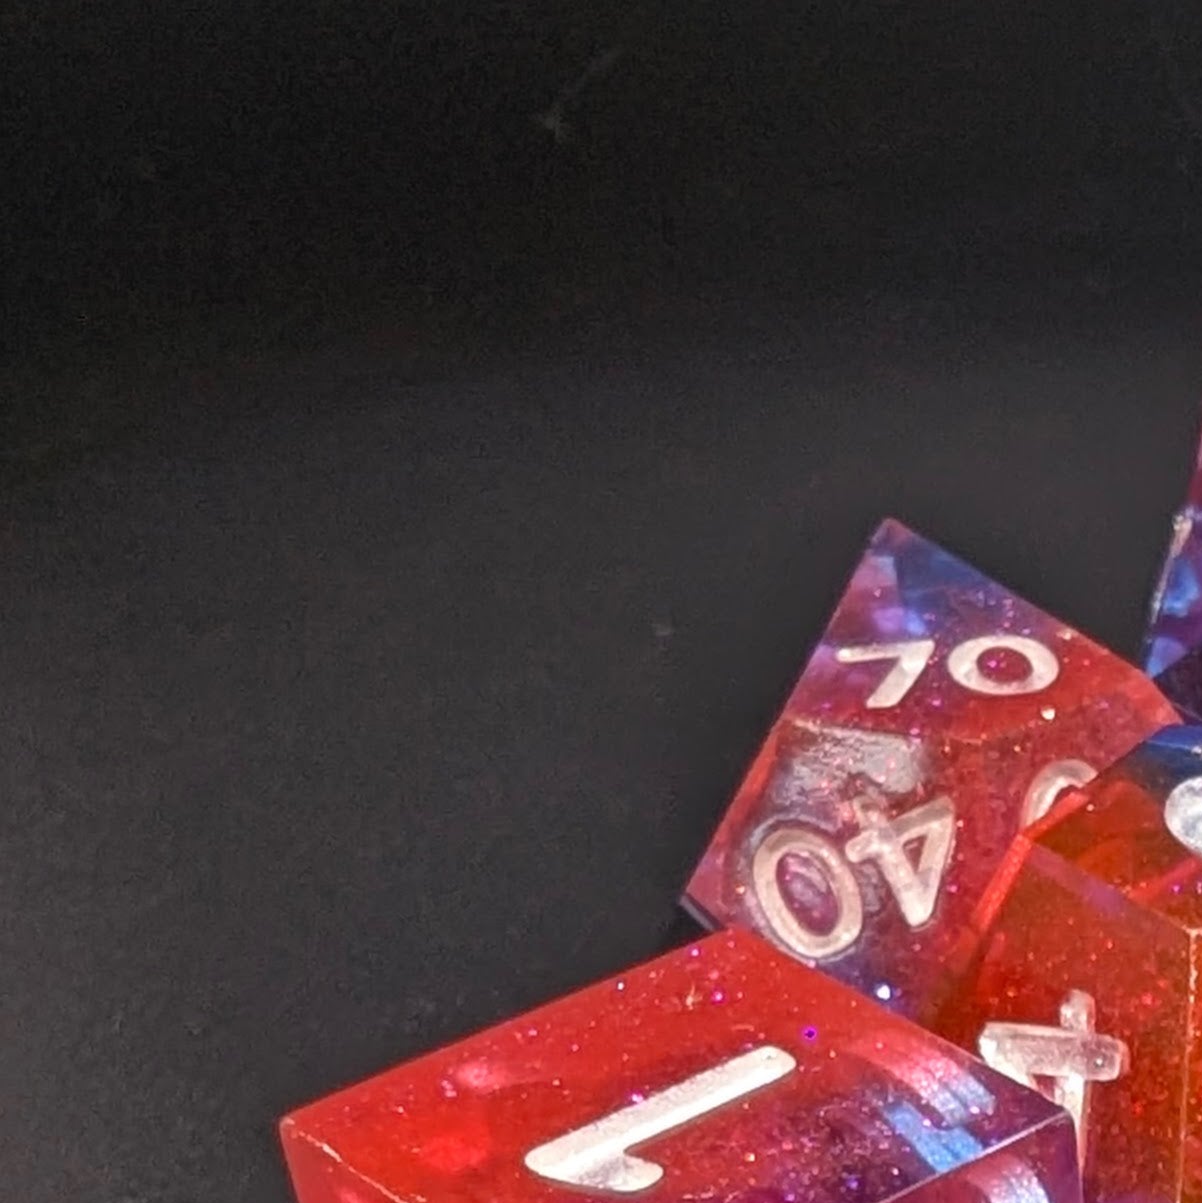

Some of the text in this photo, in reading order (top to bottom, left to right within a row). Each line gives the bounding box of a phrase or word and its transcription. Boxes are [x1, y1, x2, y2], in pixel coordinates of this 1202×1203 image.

[835, 634, 1061, 710] 70
[752, 795, 958, 960] 40
[523, 1044, 798, 1194] 1
